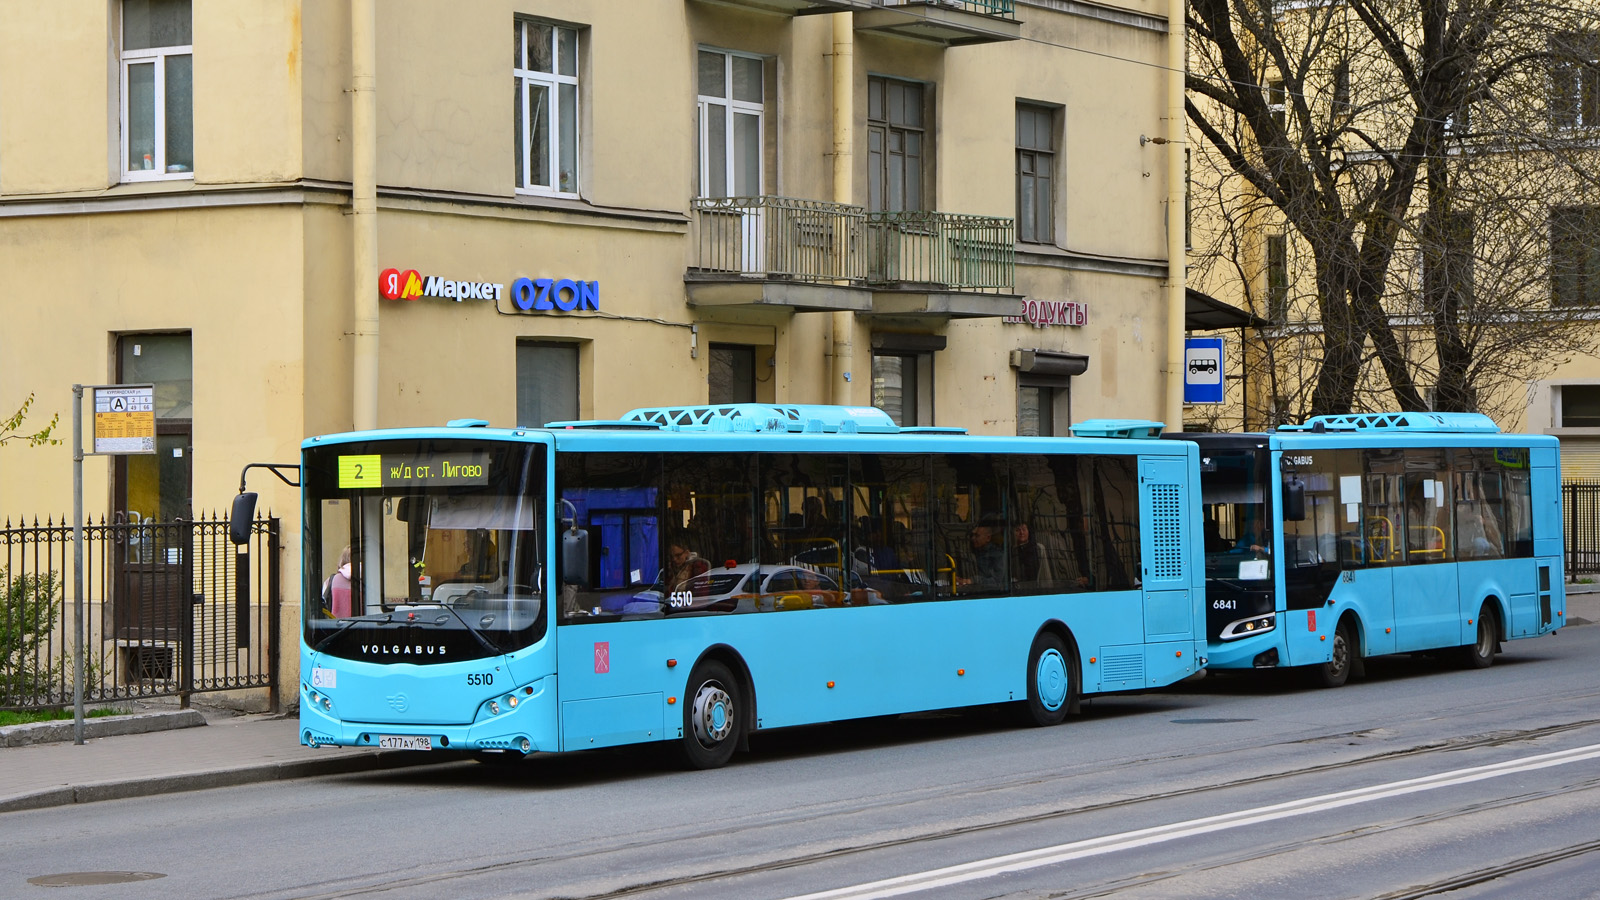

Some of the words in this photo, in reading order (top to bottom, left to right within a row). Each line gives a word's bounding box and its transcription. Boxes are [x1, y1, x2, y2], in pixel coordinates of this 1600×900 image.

[388, 273, 398, 295] Я
[424, 276, 504, 302] Маркет
[511, 277, 600, 312] OZON
[1007, 300, 1088, 328] РОДУКТЫ
[114, 398, 124, 410] А
[354, 463, 364, 480] 2
[390, 462, 412, 479] ж/д
[416, 465, 435, 479] ст.
[442, 461, 482, 478] Лигово
[670, 590, 693, 608] 5510
[1213, 599, 1237, 610] 6841
[361, 644, 446, 655] VOLGABUS
[467, 672, 494, 686] 5510
[415, 737, 430, 746] 198
